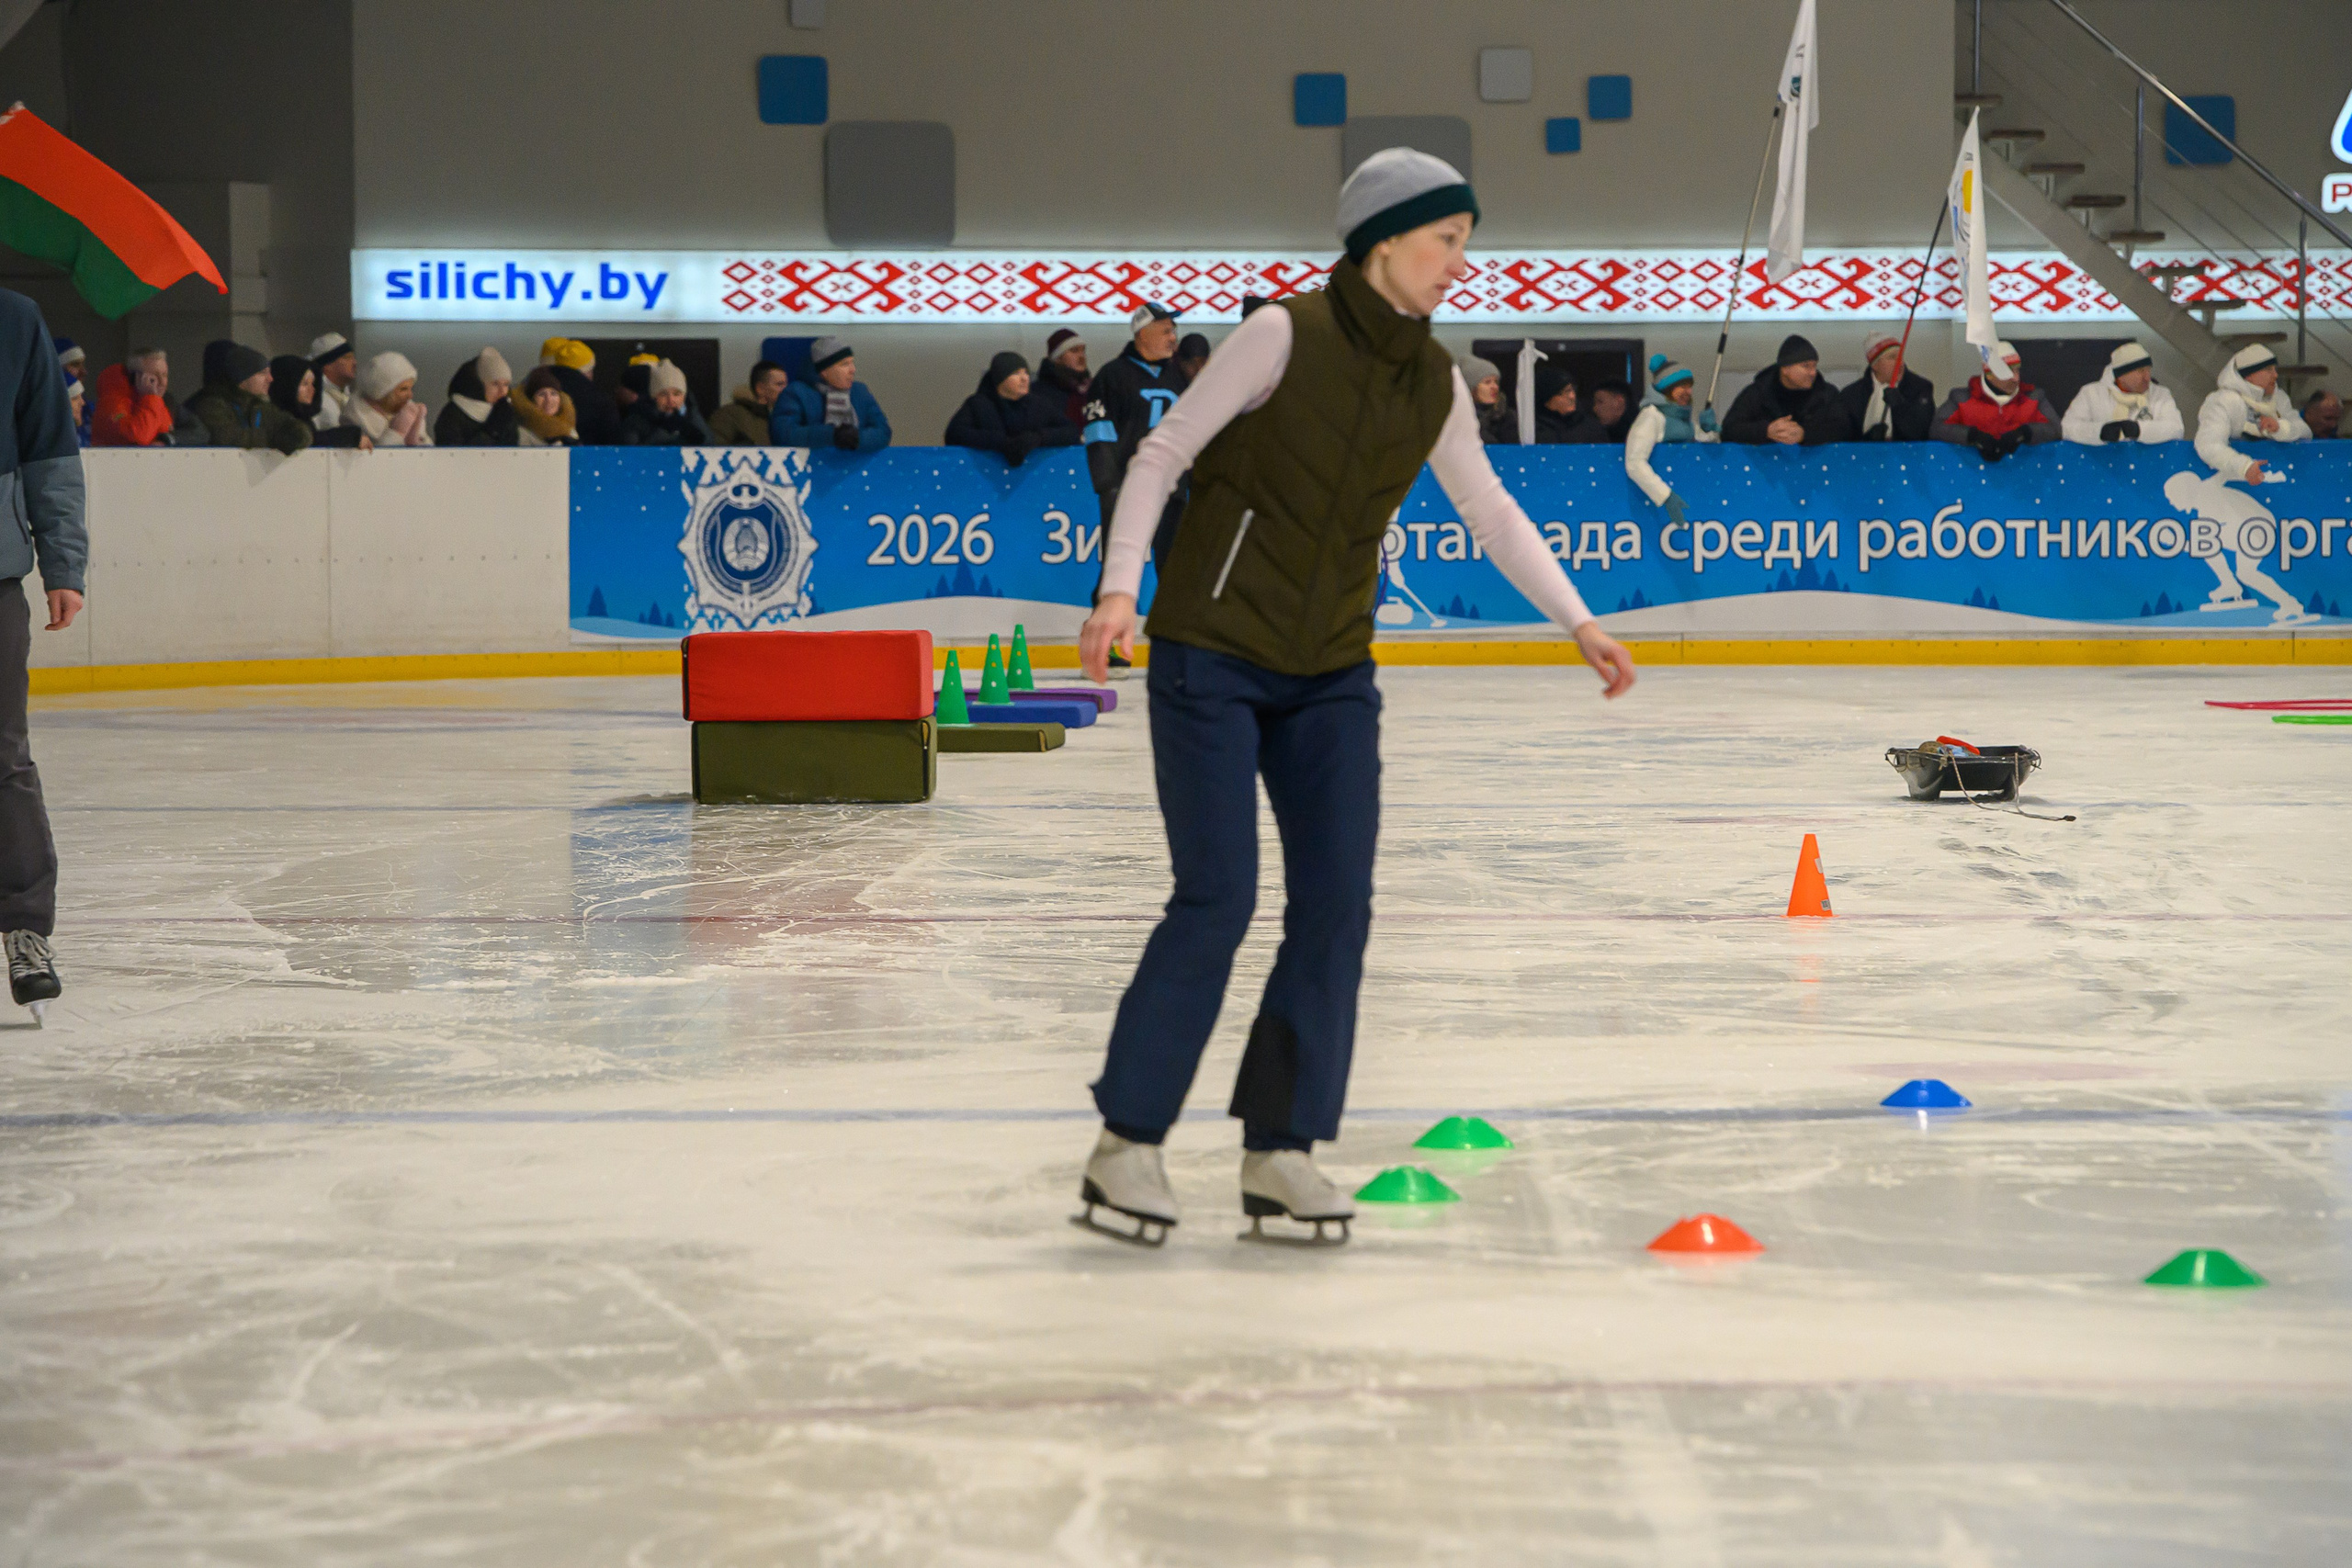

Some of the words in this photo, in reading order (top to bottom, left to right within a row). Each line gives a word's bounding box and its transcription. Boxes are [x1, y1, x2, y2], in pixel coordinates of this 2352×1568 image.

[386, 262, 669, 310] silichy.by
[866, 512, 995, 566] 2026
[1659, 519, 1838, 574] среди
[1859, 502, 2224, 573] работников
[2237, 516, 2352, 571] орг
